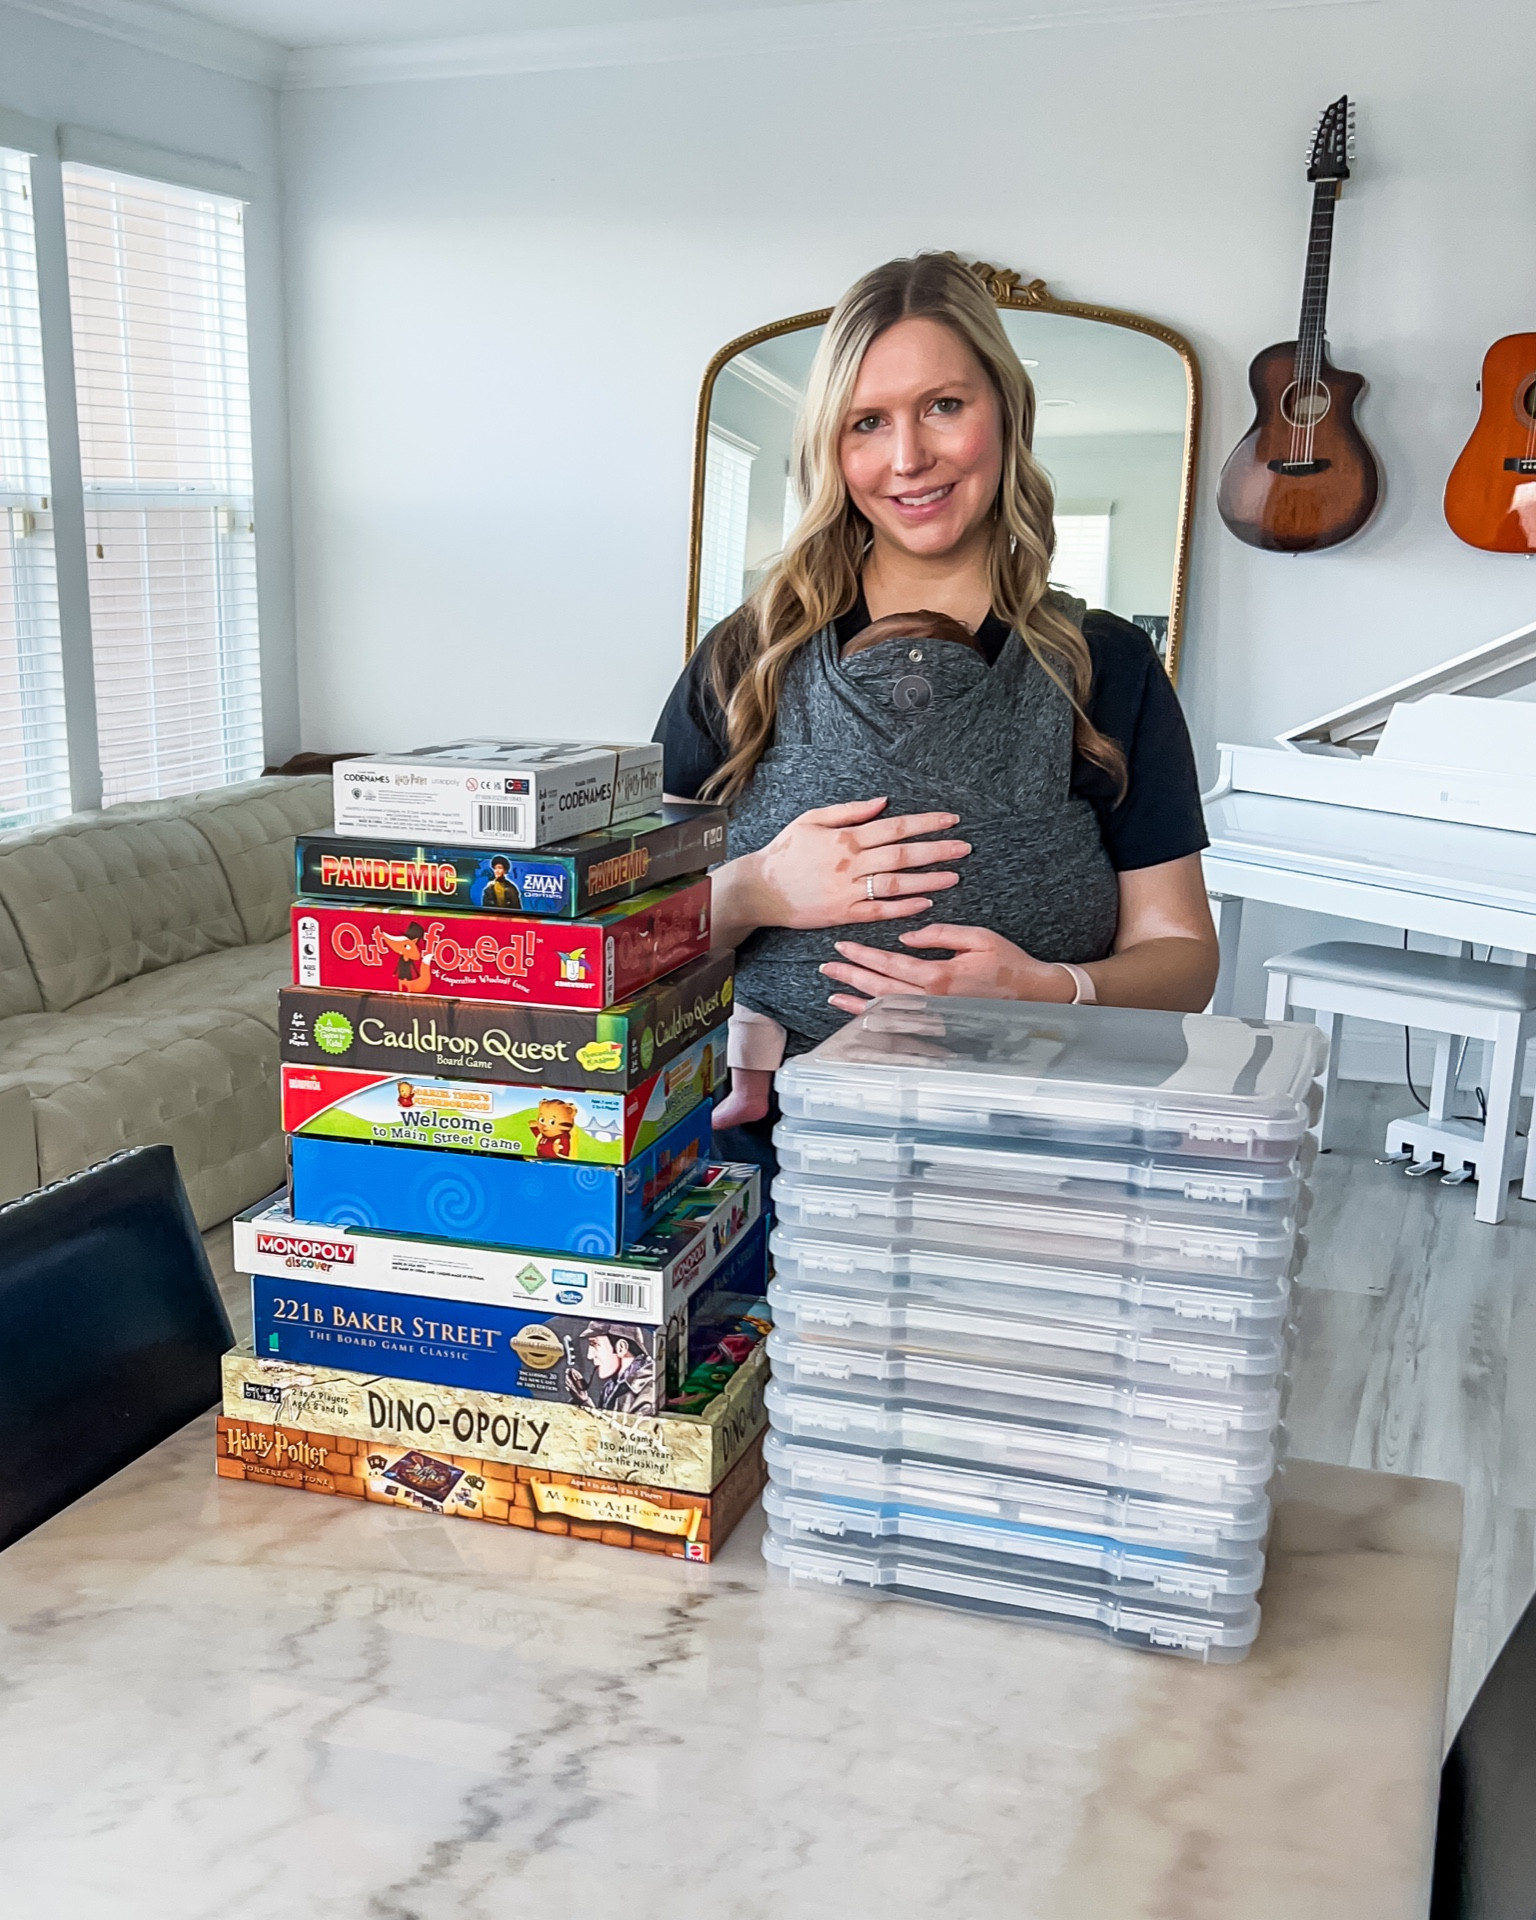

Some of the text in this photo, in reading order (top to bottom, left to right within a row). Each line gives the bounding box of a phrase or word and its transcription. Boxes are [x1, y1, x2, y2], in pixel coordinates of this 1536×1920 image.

[344, 773, 390, 783] CODENAMES
[559, 783, 611, 811] CODENAMES
[321, 855, 457, 895] PANDEMIC
[588, 847, 649, 896] PANDEMIC
[358, 1018, 570, 1073] Cauldron Quest
[436, 1053, 493, 1069] Board Game
[401, 1111, 493, 1134] Welcome
[373, 1126, 521, 1150] to Main Street Game
[259, 1237, 353, 1261] MONOPOLY
[285, 1257, 333, 1272] discover
[332, 1306, 406, 1335] BAKER
[412, 1317, 498, 1348] STREET
[308, 1329, 470, 1361] THE BOARD GAME CLASSIC
[292, 1388, 297, 1396] 2
[311, 1390, 316, 1399] 6
[319, 1392, 349, 1405] Players
[292, 1400, 349, 1417] Ages 8 and Up
[368, 1390, 550, 1455] DINO-OPOLY
[226, 1428, 328, 1469] Harry Potter
[620, 1431, 654, 1445] A Game
[600, 1441, 674, 1461] 150 Million Years
[605, 1455, 669, 1475] in the Making!
[299, 1473, 329, 1486] STONE
[545, 1490, 688, 1523] MYSTERY AT HOGWARTS
[598, 1510, 630, 1521] GAME
